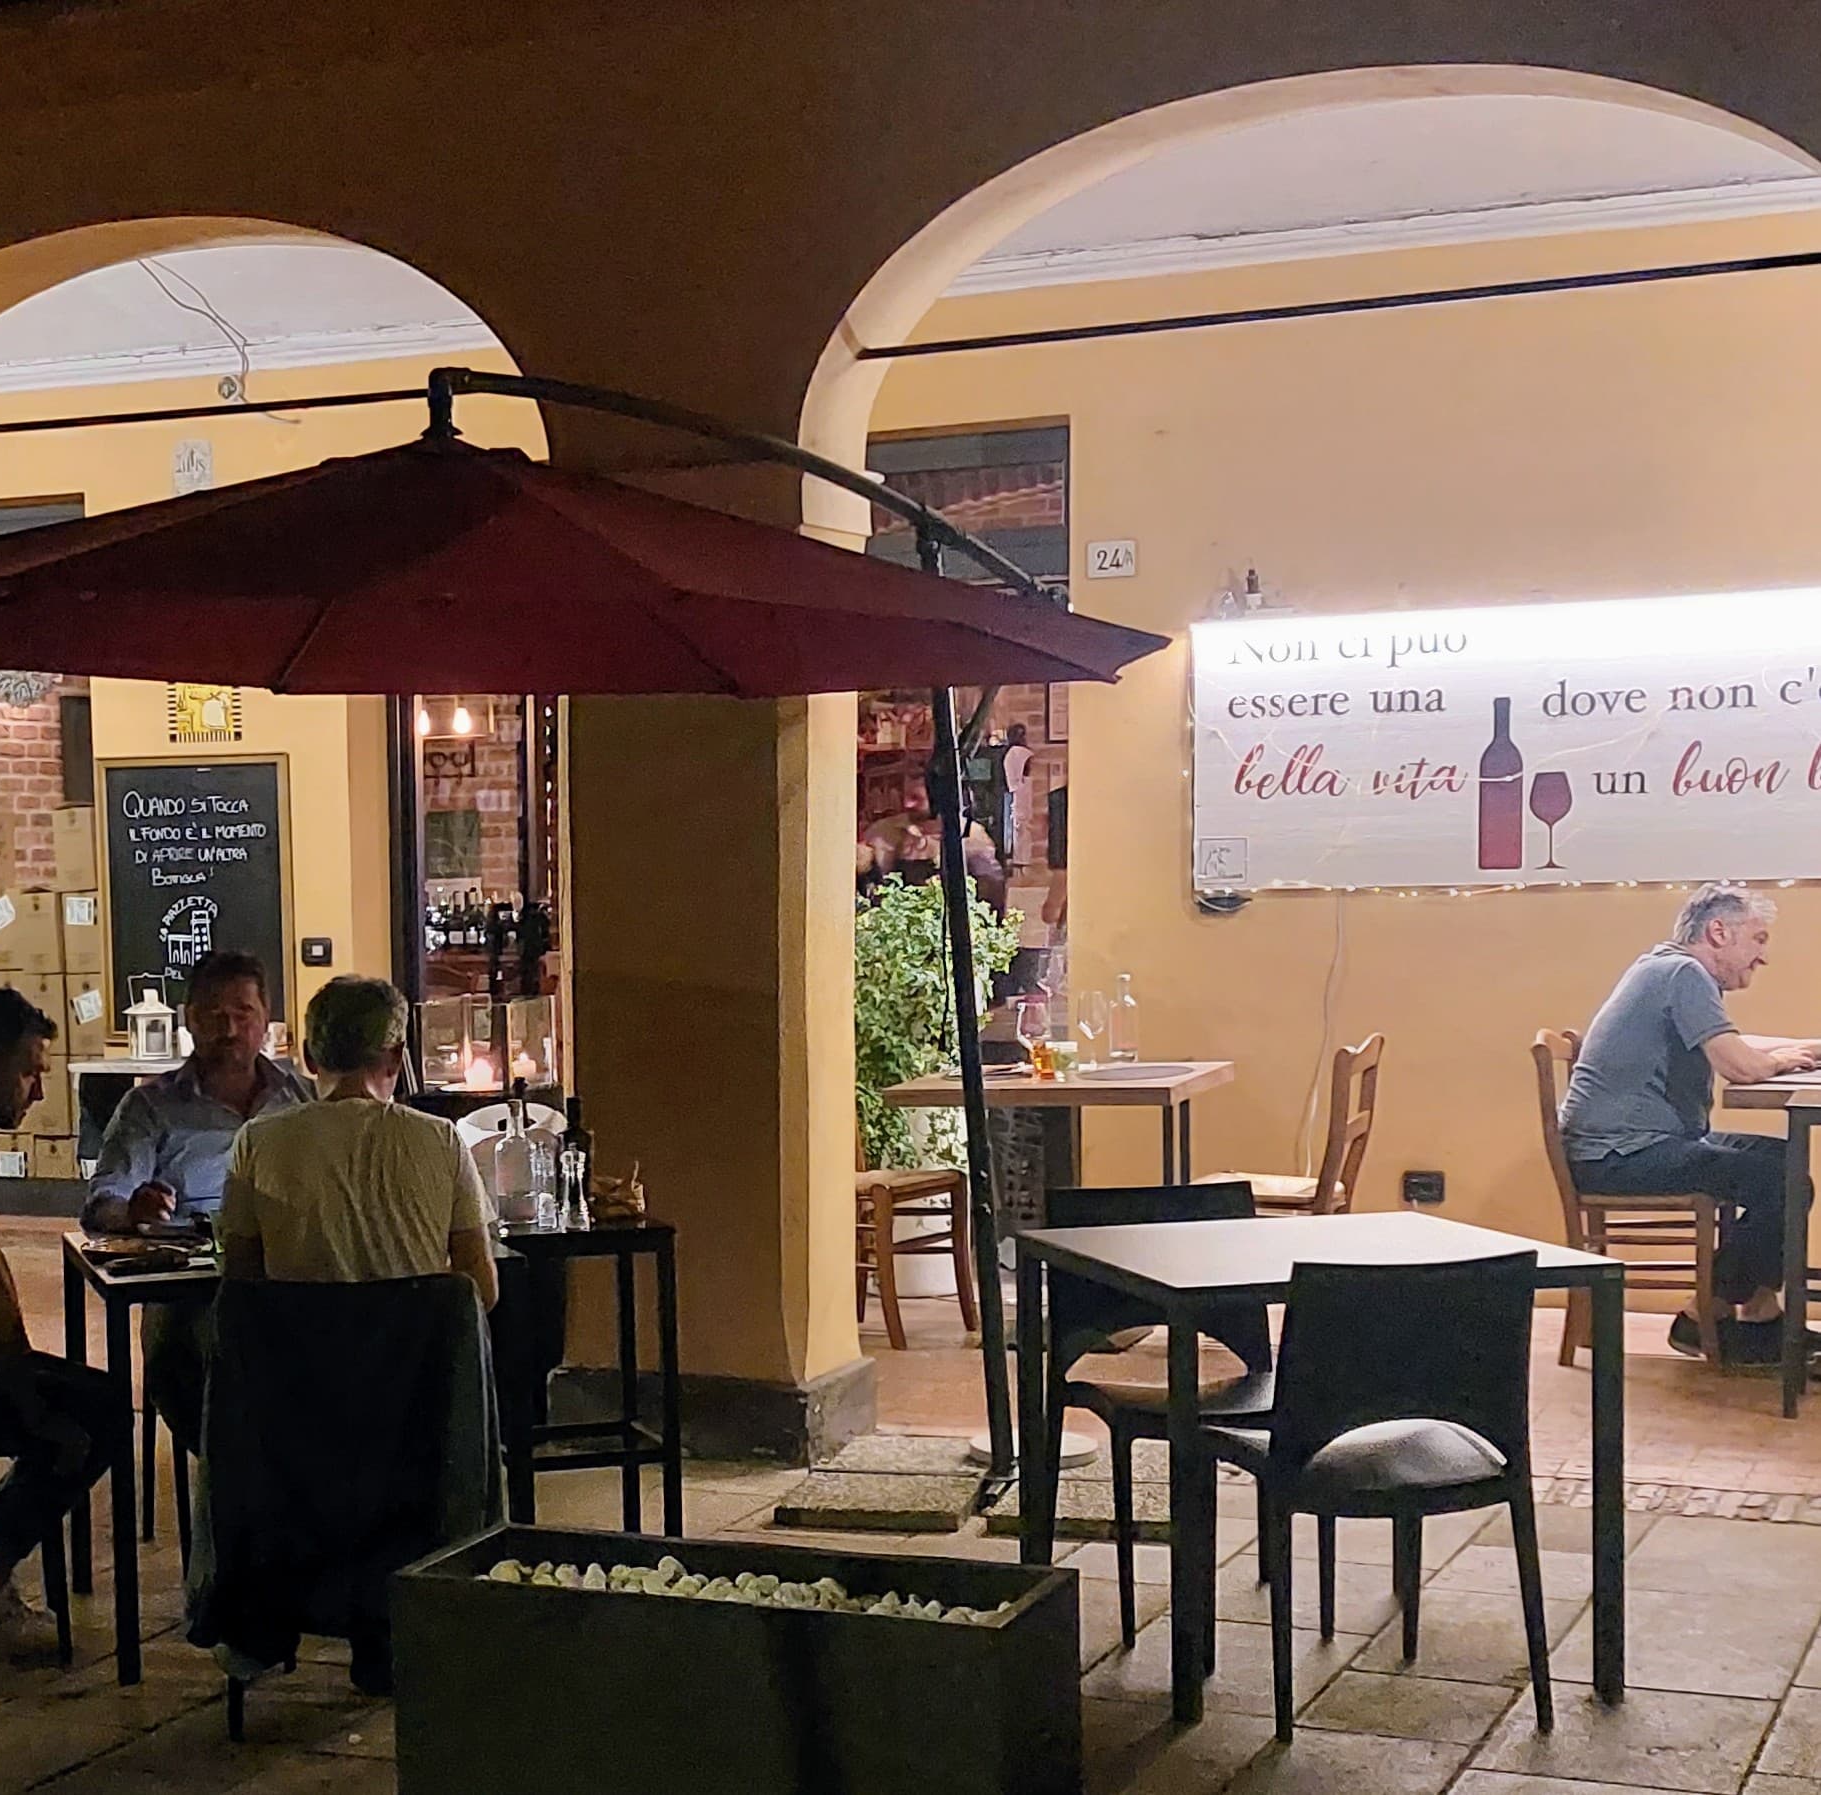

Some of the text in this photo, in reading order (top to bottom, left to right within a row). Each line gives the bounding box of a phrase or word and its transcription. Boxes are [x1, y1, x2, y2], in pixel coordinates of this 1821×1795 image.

[1227, 638, 1320, 666] Non
[1227, 686, 1447, 719] essere una
[1541, 666, 1821, 718] dove non c'
[1233, 742, 1469, 801] bella vita
[1591, 769, 1650, 795] un
[1671, 739, 1791, 797] buon
[122, 790, 186, 819] QUANDO
[207, 795, 250, 814] TOCCA
[140, 826, 181, 841] FONDO
[214, 824, 267, 840] MOMENTO
